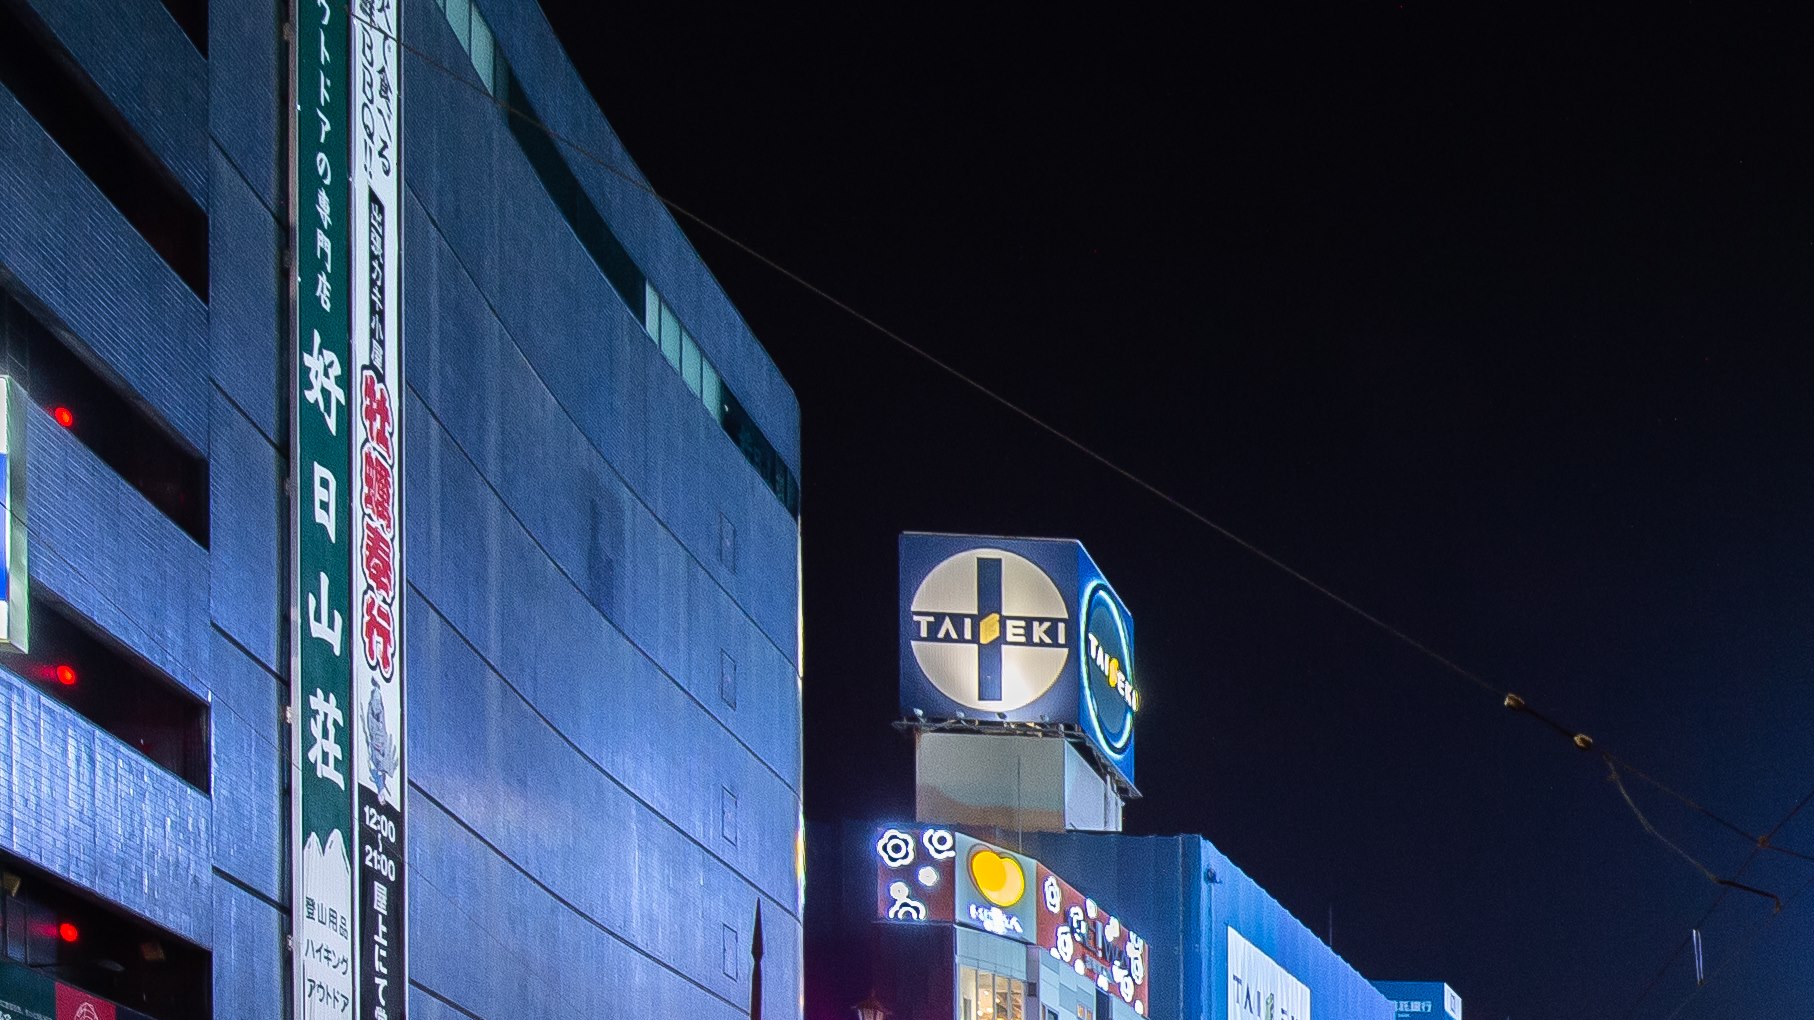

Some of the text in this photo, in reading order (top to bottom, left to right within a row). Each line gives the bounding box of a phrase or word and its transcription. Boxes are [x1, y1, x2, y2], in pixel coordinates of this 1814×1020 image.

[302, 329, 345, 790] 好日山荘
[363, 805, 396, 843] 12:00
[364, 845, 396, 882] 21:00
[306, 897, 348, 940] 登山用品
[305, 938, 348, 975] ハイキング
[307, 978, 349, 1013] アウトドア
